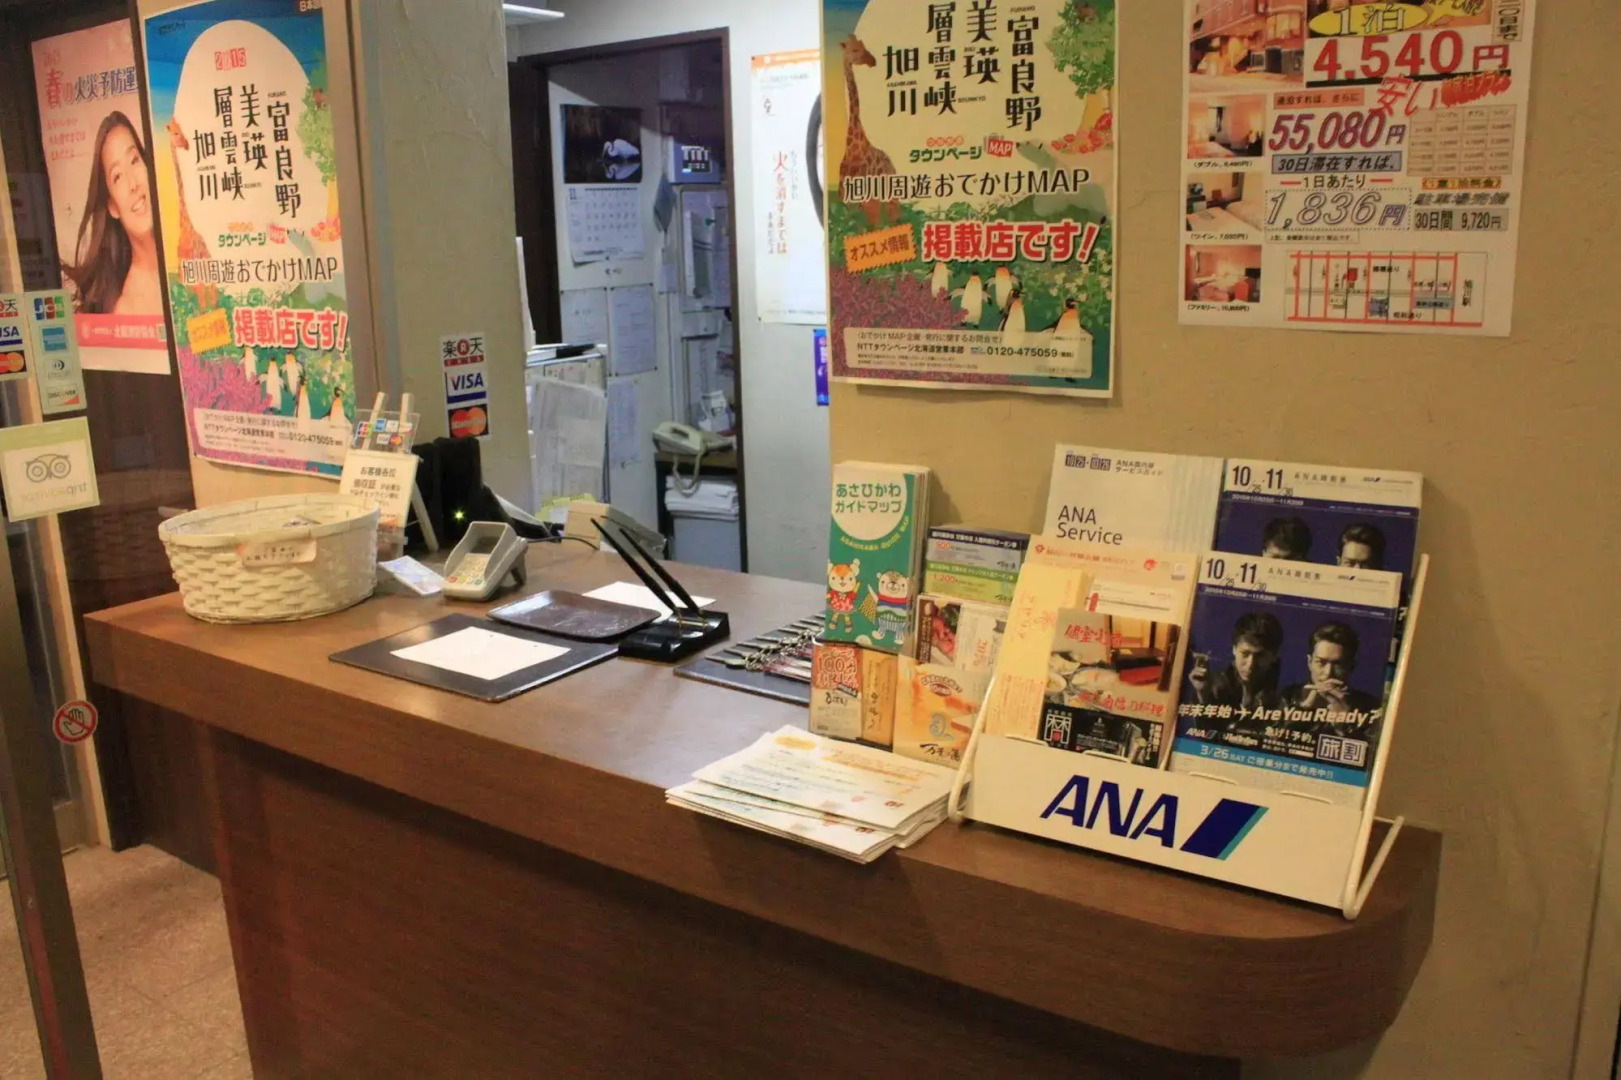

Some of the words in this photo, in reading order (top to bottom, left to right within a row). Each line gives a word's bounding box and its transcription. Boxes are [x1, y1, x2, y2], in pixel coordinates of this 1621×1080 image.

[963, 0, 1000, 85] 美瑛
[924, 1, 957, 116] 層雲峡
[1006, 15, 1042, 131] 富良野
[47, 66, 139, 109] 春の火災予防運
[882, 46, 919, 117] 旭川
[240, 84, 268, 170] 美瑛
[1268, 111, 1406, 154] 55,080円
[213, 86, 245, 200] 層雲峡
[909, 146, 982, 163] タウンページ
[988, 140, 1014, 157] MAP
[193, 130, 218, 200] 旭川
[267, 101, 301, 219] 富良野
[844, 169, 1089, 201] 旭川周遊おでかけMAP
[1304, 174, 1366, 189] 1日あたり
[1267, 191, 1407, 229] 1,836円
[1415, 210, 1453, 230] 30日間
[218, 232, 267, 248] タウンページ
[850, 234, 910, 259] オススメ情報
[183, 257, 337, 284] 旭川周遊おでかけMAP
[986, 346, 1058, 358] 0120-475059
[451, 372, 484, 391] VISA
[836, 483, 901, 498] あさひかわ
[835, 500, 901, 514] ガイドマップ
[1058, 504, 1097, 525] ANA
[1056, 521, 1123, 546] Service
[1179, 703, 1232, 719] 年末年始
[1251, 706, 1280, 721] Are
[1282, 707, 1313, 722] You
[1313, 707, 1382, 727] Ready?
[1039, 774, 1180, 849] ANA
